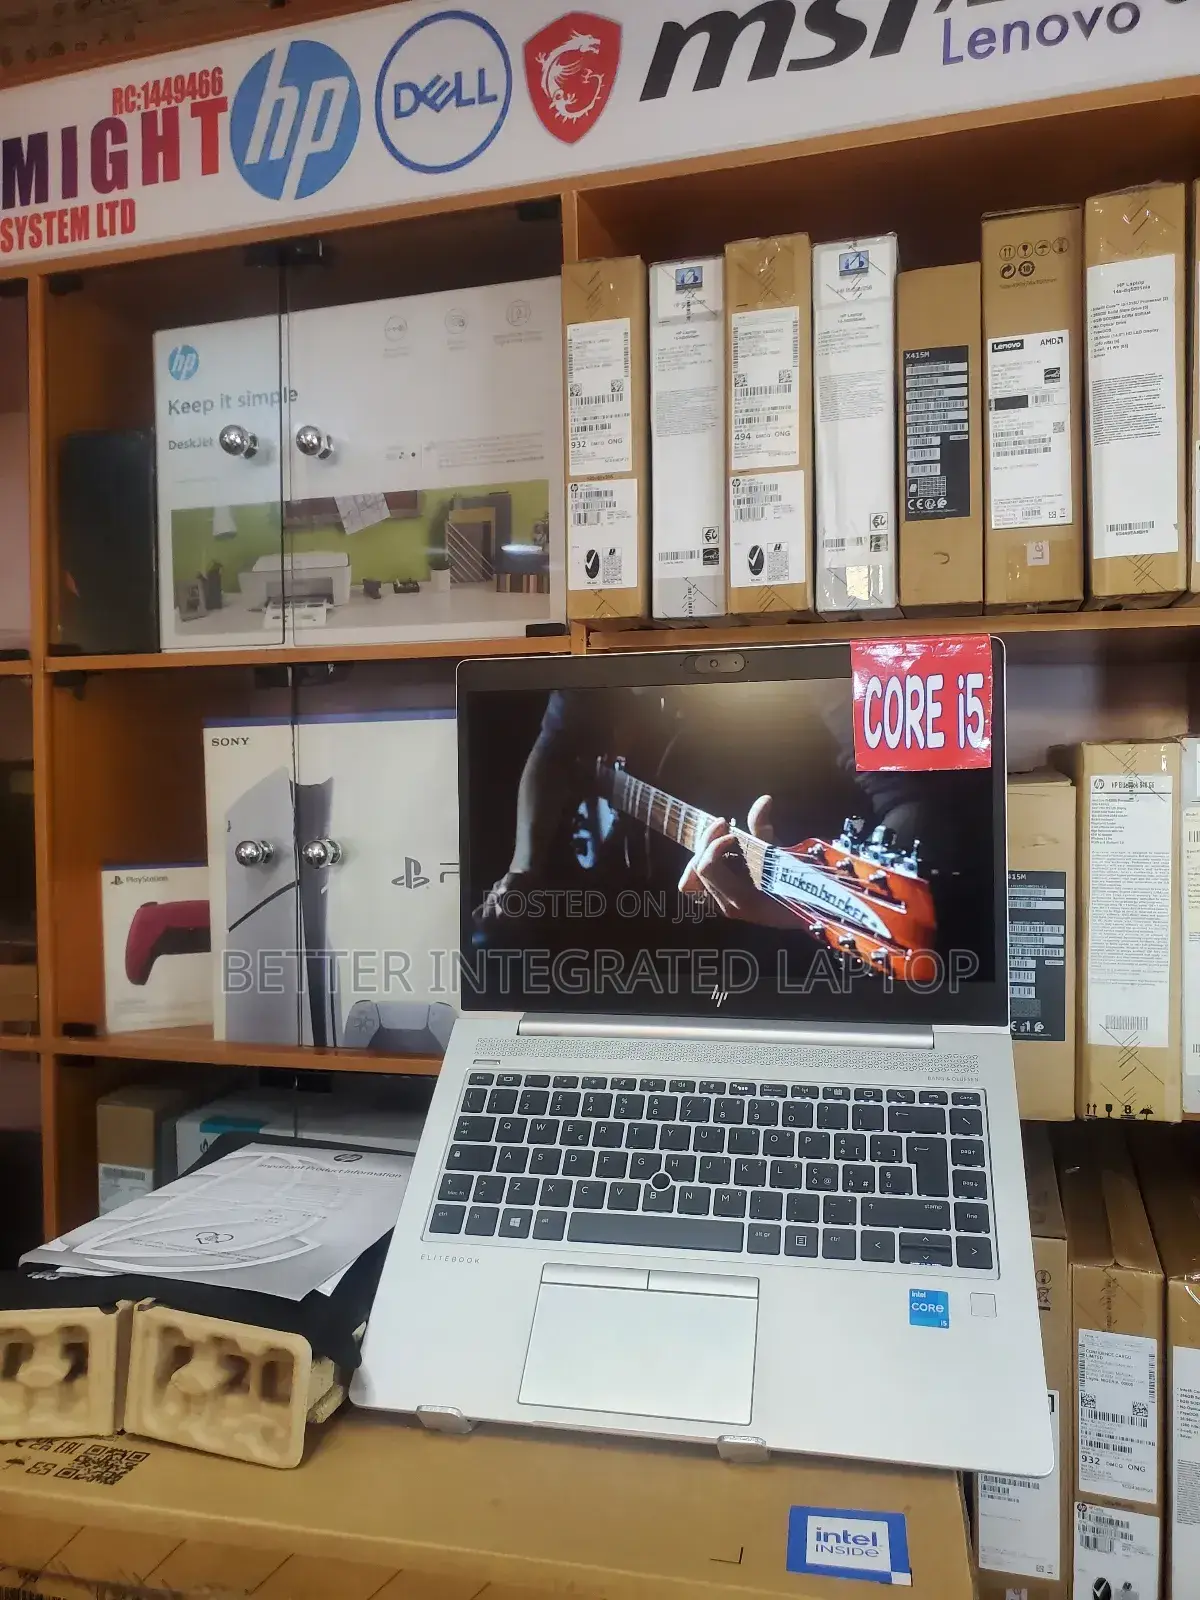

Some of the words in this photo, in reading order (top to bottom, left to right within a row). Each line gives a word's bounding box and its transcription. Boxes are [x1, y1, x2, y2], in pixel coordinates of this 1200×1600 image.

[942, 2, 1141, 65] Lenovo
[112, 66, 224, 116] RC:1449466
[393, 67, 498, 120] DELL
[1, 97, 229, 209] MIGHT
[0, 206, 89, 252] SYSTEM
[97, 198, 136, 238] LTD
[1040, 337, 1057, 346] AMD
[993, 342, 1022, 350] Lenovo
[905, 351, 930, 359] X415M
[168, 399, 214, 416] Keep
[220, 393, 232, 409] it
[237, 386, 298, 408] simple
[734, 432, 751, 441] 494
[774, 430, 791, 438] ONG
[168, 437, 213, 450] DeskJet
[571, 440, 587, 449] 932
[863, 673, 945, 750] CORE
[957, 672, 985, 750] i5
[211, 737, 249, 747] SONY
[126, 875, 169, 884] PlayStation
[503, 1122, 512, 1130] Q
[536, 1123, 546, 1131] W
[567, 1124, 574, 1132] E
[599, 1126, 607, 1134] R
[633, 1127, 639, 1135] T
[667, 1129, 674, 1137] Y
[700, 1131, 708, 1139] U
[804, 1136, 811, 1144] P
[504, 1151, 512, 1159] A
[537, 1153, 544, 1161] S
[570, 1154, 577, 1162] D
[637, 1157, 645, 1165] G
[671, 1159, 679, 1167] H
[706, 1161, 712, 1169] J
[741, 1163, 749, 1172] K
[777, 1166, 783, 1174] L
[513, 1182, 521, 1190] Z
[547, 1184, 555, 1192] X
[581, 1186, 589, 1194] C
[650, 1191, 657, 1199] B
[685, 1192, 693, 1200] N
[721, 1194, 730, 1202] M
[420, 1254, 480, 1264] ELITEBOOK
[1081, 1454, 1101, 1465] 932
[1127, 1463, 1146, 1472] ONG
[815, 1526, 878, 1547] intel
